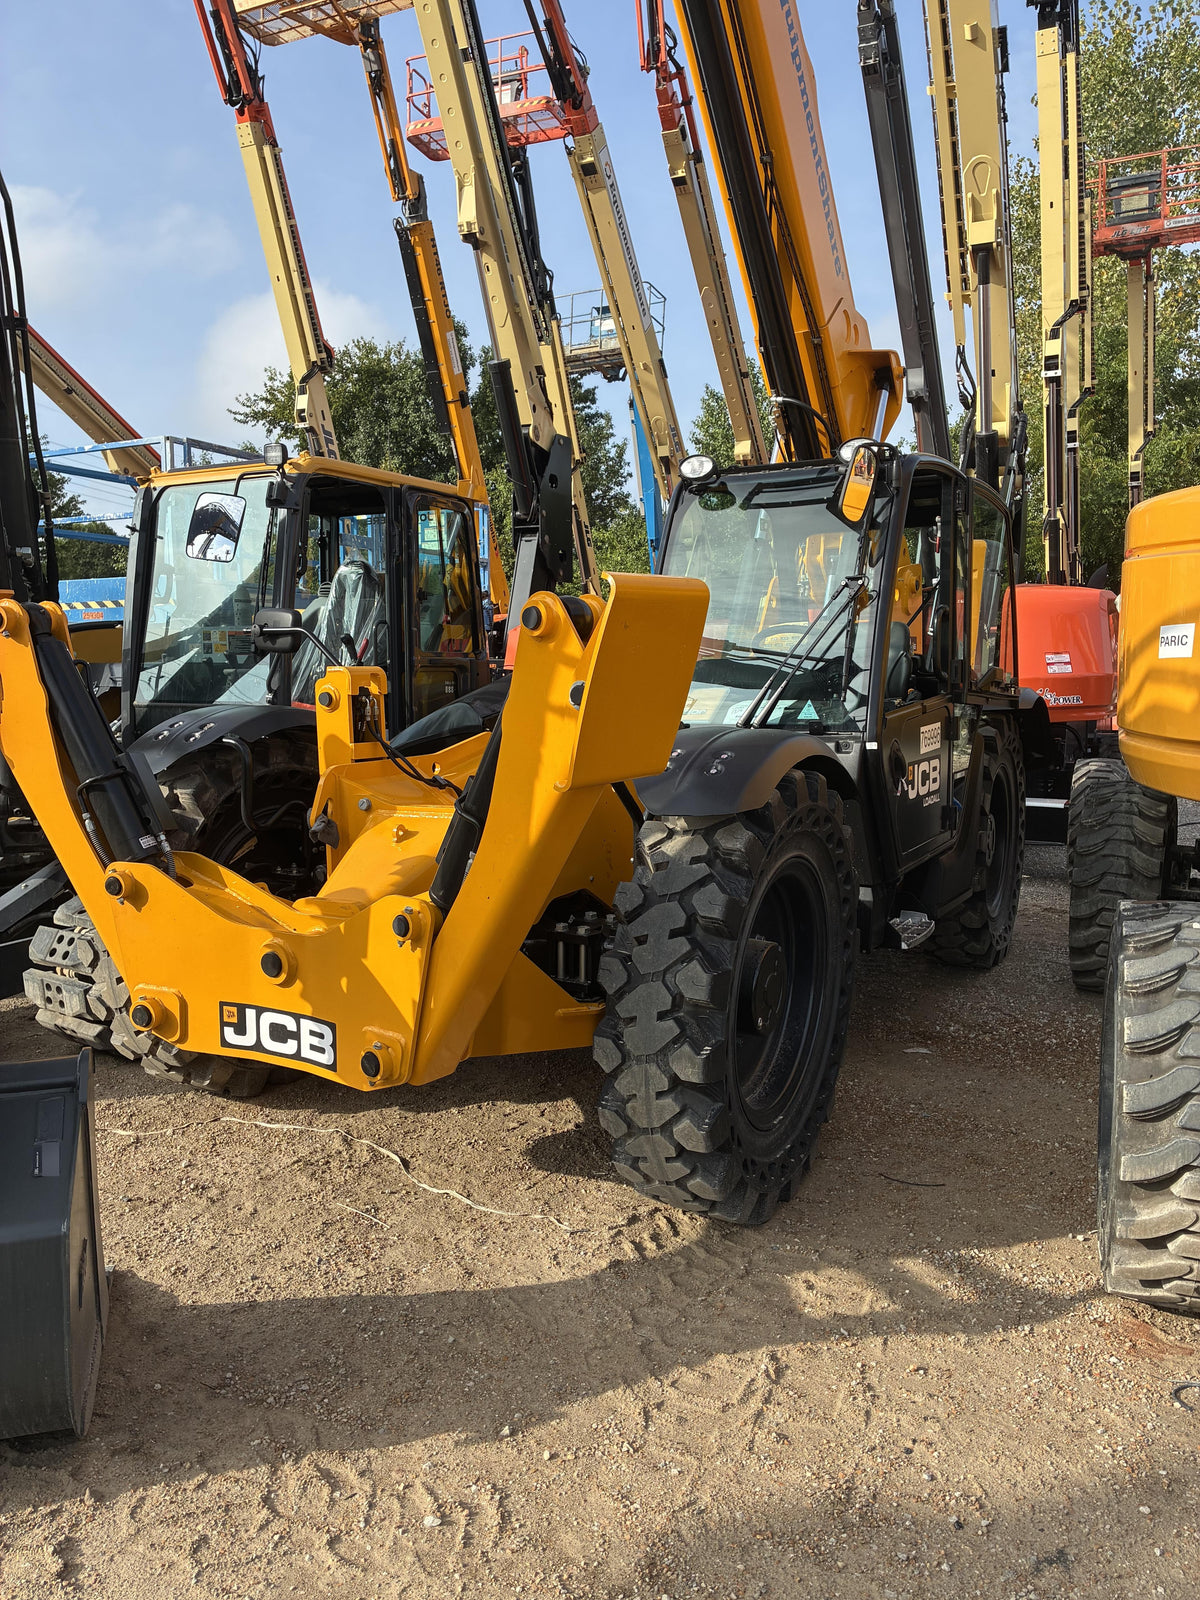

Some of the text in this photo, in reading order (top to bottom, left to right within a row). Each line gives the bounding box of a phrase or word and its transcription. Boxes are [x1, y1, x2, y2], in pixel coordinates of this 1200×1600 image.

[609, 184, 647, 317] EquipmentShare
[669, 424, 681, 453] JLG
[583, 521, 593, 548] JLG
[1160, 635, 1188, 647] PARIC
[909, 759, 940, 800] JCB
[224, 1008, 335, 1065] JCB
